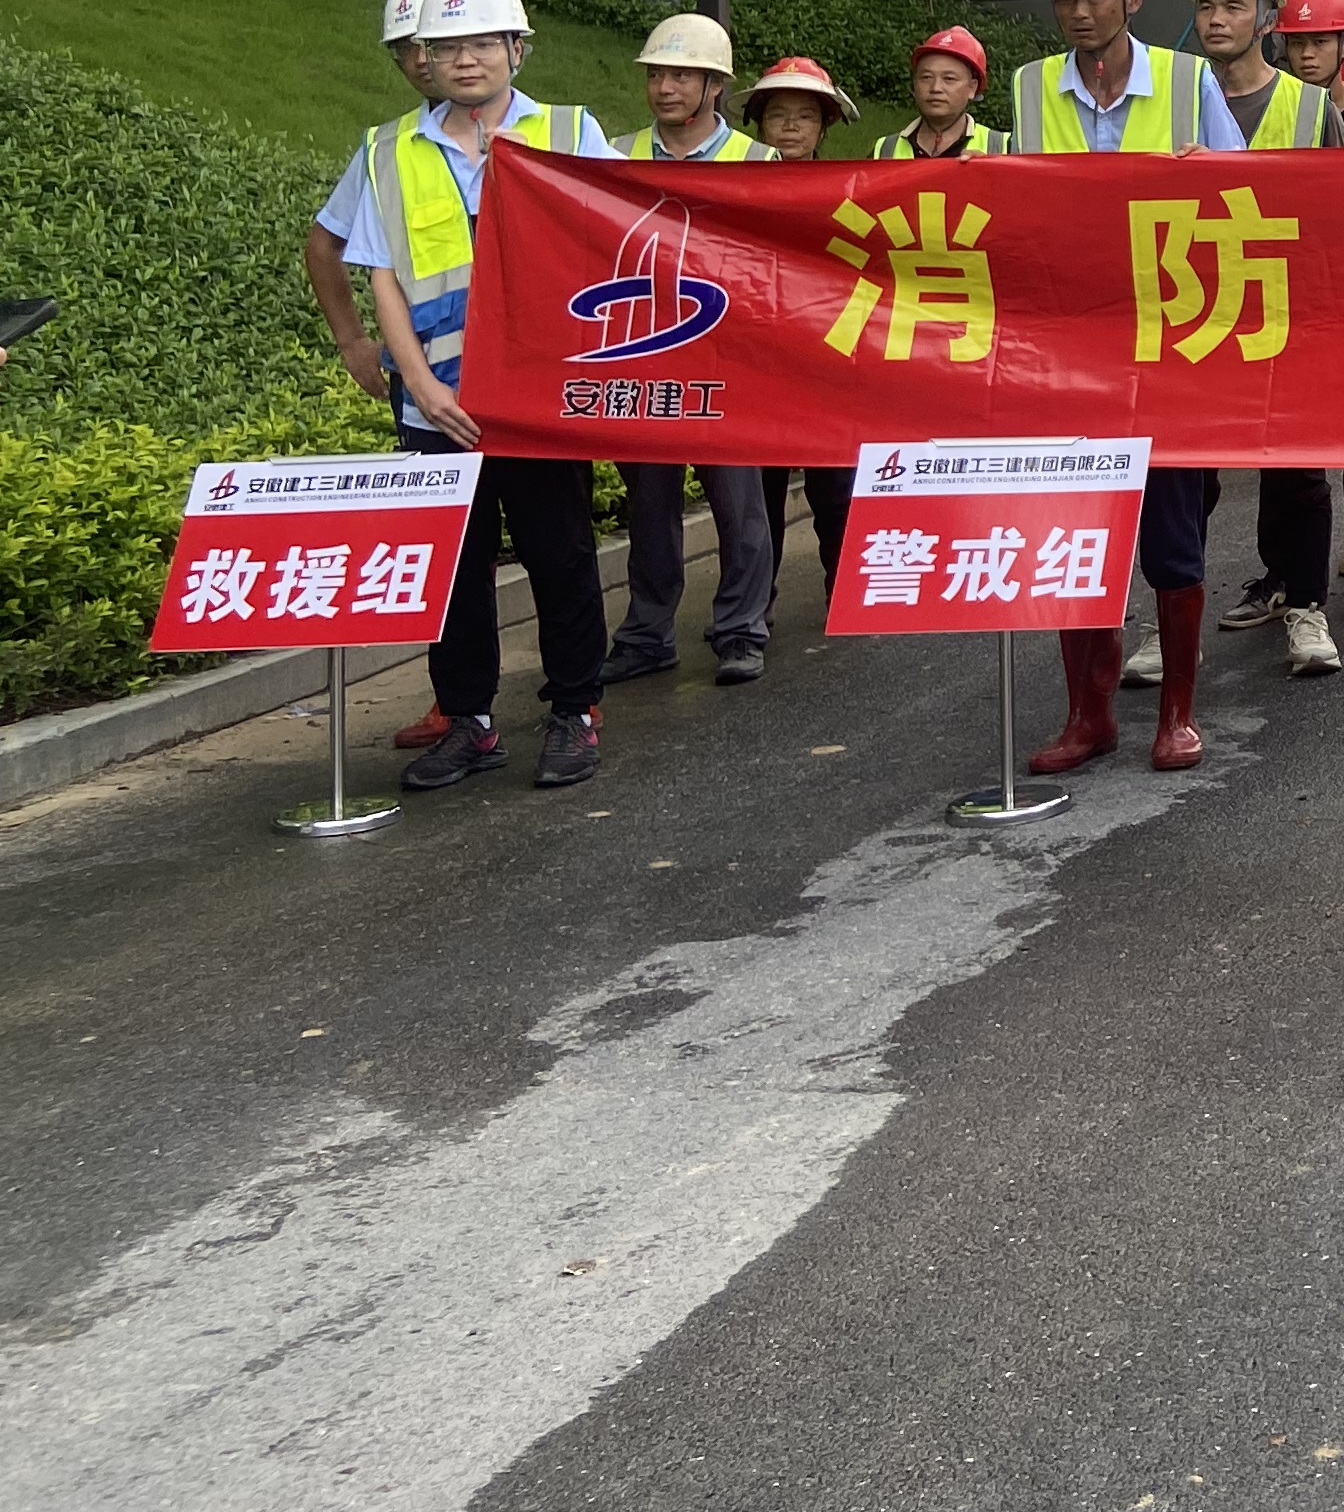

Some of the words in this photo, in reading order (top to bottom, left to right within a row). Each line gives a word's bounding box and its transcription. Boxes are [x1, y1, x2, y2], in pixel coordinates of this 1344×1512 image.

[560, 378, 726, 420] 安徽建工
[247, 469, 461, 494] 安徽建工三建集团有限公司
[914, 454, 1131, 475] 安徽建工三建集团有限公司
[181, 542, 434, 623] 救援组
[859, 526, 1109, 606] 警戒组
